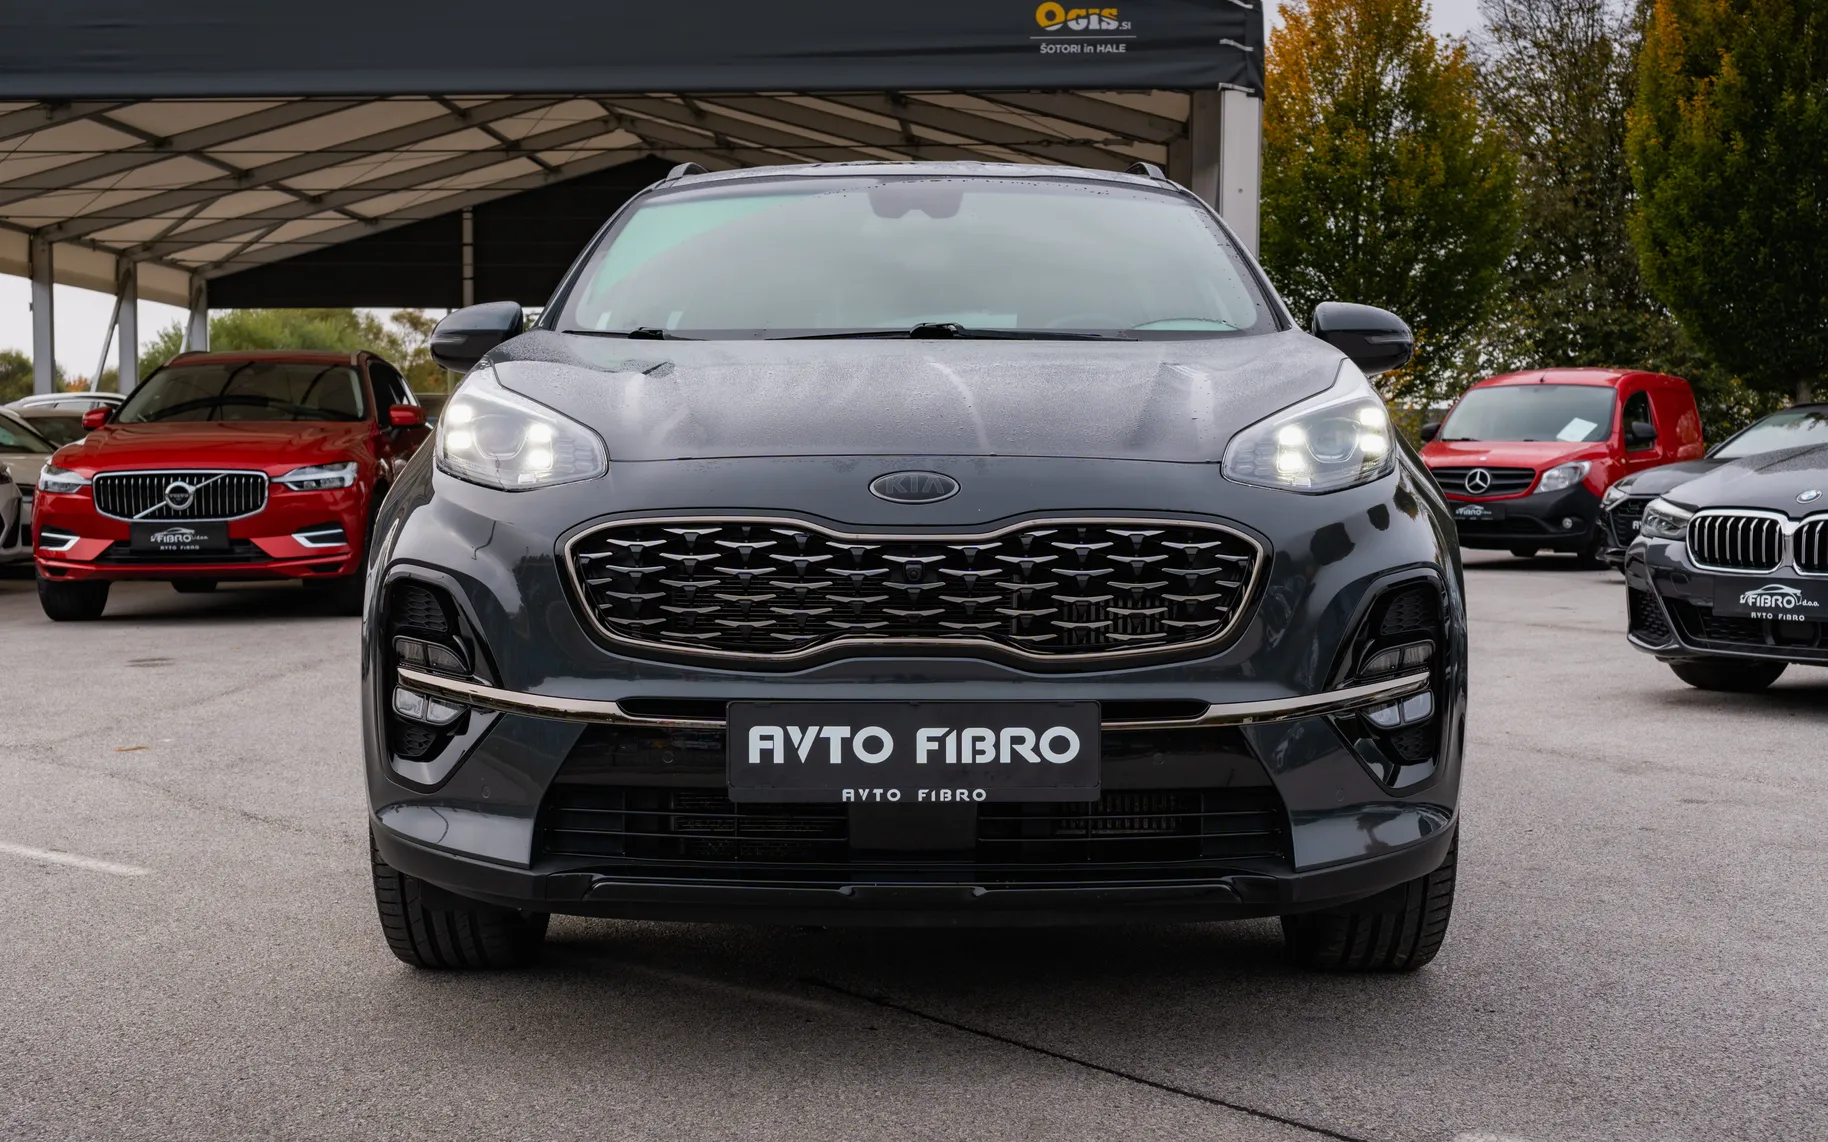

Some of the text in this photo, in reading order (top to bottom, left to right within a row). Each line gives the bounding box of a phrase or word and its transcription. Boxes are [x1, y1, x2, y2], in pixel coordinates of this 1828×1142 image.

[1040, 42, 1126, 53] ŠOTORI in HALE
[886, 475, 945, 494] KIA
[157, 534, 192, 543] FIBRO
[1749, 594, 1820, 608] FIBRO d.o.o.
[1778, 613, 1805, 621] FIBRO
[748, 725, 1080, 764] AVTO FIBRO
[842, 788, 987, 802] AVTO FIBRO
